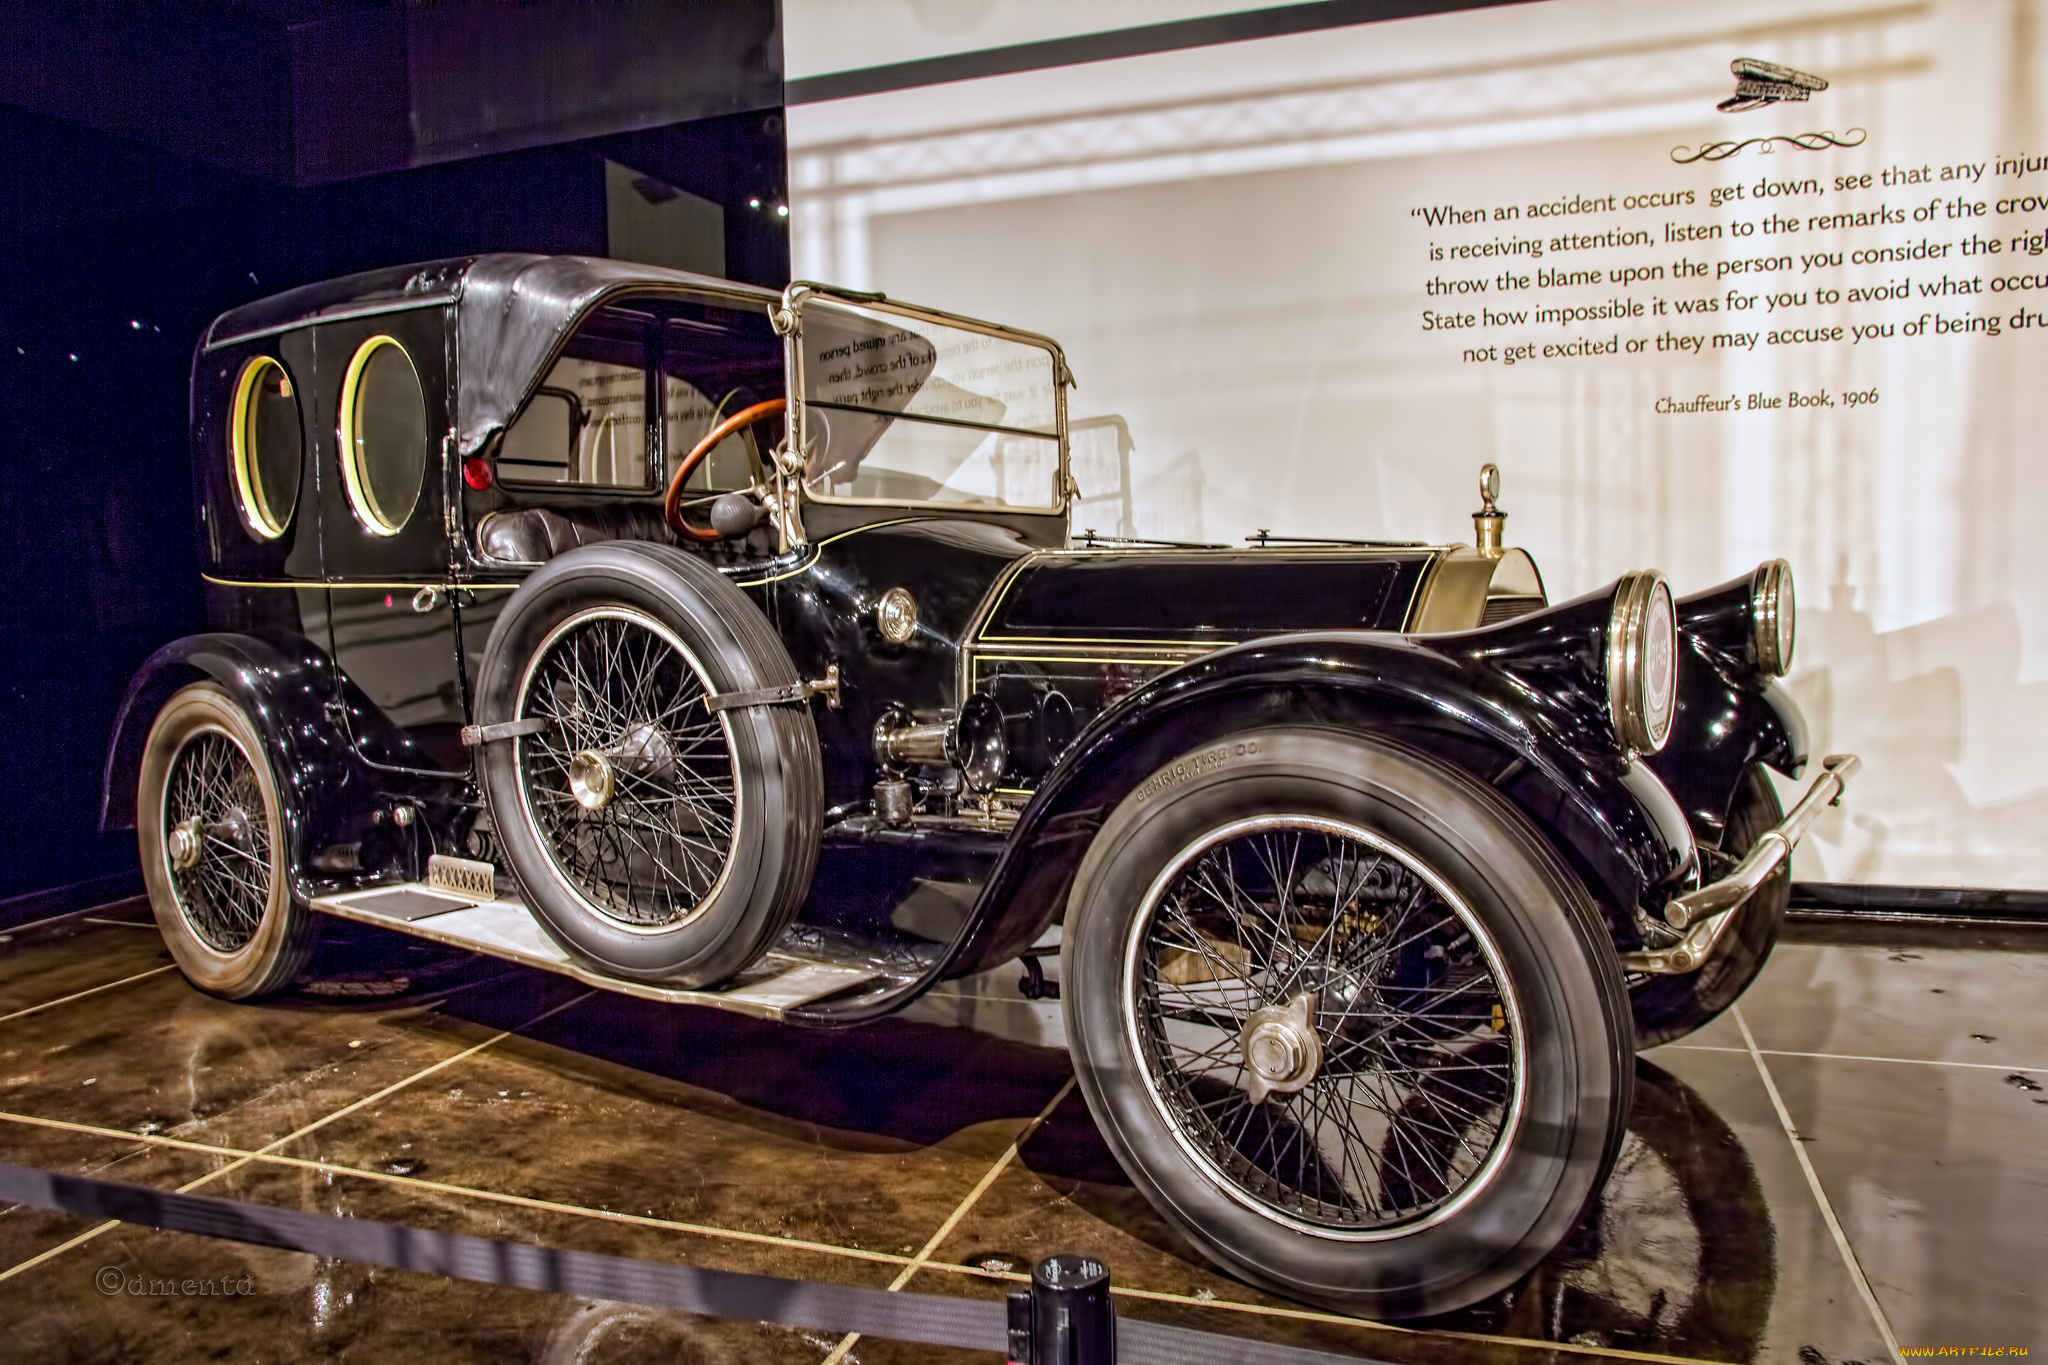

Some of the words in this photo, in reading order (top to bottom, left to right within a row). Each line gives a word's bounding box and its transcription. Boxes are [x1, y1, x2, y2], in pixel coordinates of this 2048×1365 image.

[1494, 206, 1519, 221] an
[1527, 194, 1616, 218] accident
[1623, 190, 1695, 210] occurs
[1710, 183, 1745, 207] get
[1753, 177, 1824, 198] down,
[1834, 174, 1873, 191] see
[1881, 165, 1932, 186] that
[1940, 163, 1986, 183] any
[1430, 242, 1443, 261] is
[1451, 235, 1543, 259] receiving
[1550, 227, 1654, 252] attention,
[1665, 222, 1722, 242] listen
[1731, 220, 1754, 237] to
[1762, 213, 1800, 234] the
[1808, 203, 1905, 231] remarks
[1913, 198, 1942, 222] of
[1945, 196, 1986, 219] the
[1426, 276, 1489, 296] throw
[1496, 271, 1530, 291] the
[1538, 267, 1602, 288] blame
[1610, 266, 1664, 287] upon
[1672, 257, 1709, 278] the
[1717, 256, 1792, 280] person
[1801, 252, 1843, 274] you
[1852, 238, 1952, 265] consider
[1961, 233, 2002, 256] the
[1422, 311, 1475, 331] State
[1483, 307, 1528, 326] how
[1536, 297, 1644, 326] impossible
[1653, 296, 1667, 315] it
[1674, 298, 1719, 314] was
[1726, 290, 1758, 311] for
[1766, 292, 1807, 313] you
[1815, 288, 1840, 305] to
[1848, 277, 1910, 303] avoid
[1918, 274, 1982, 297] what
[1463, 345, 1497, 362] not
[1504, 342, 1536, 365] get
[1543, 334, 1618, 358] excited
[1626, 339, 1648, 353] or
[1656, 331, 1705, 354] they
[1712, 332, 1759, 351] may
[1767, 327, 1843, 345] accuse
[1851, 324, 1894, 345] you
[1903, 314, 1931, 336] of
[1935, 312, 2001, 336] being
[1748, 392, 1782, 410] Blue
[1788, 389, 1835, 408] Book,
[1842, 388, 1879, 408] 1906
[1192, 747, 1228, 770] TIRE
